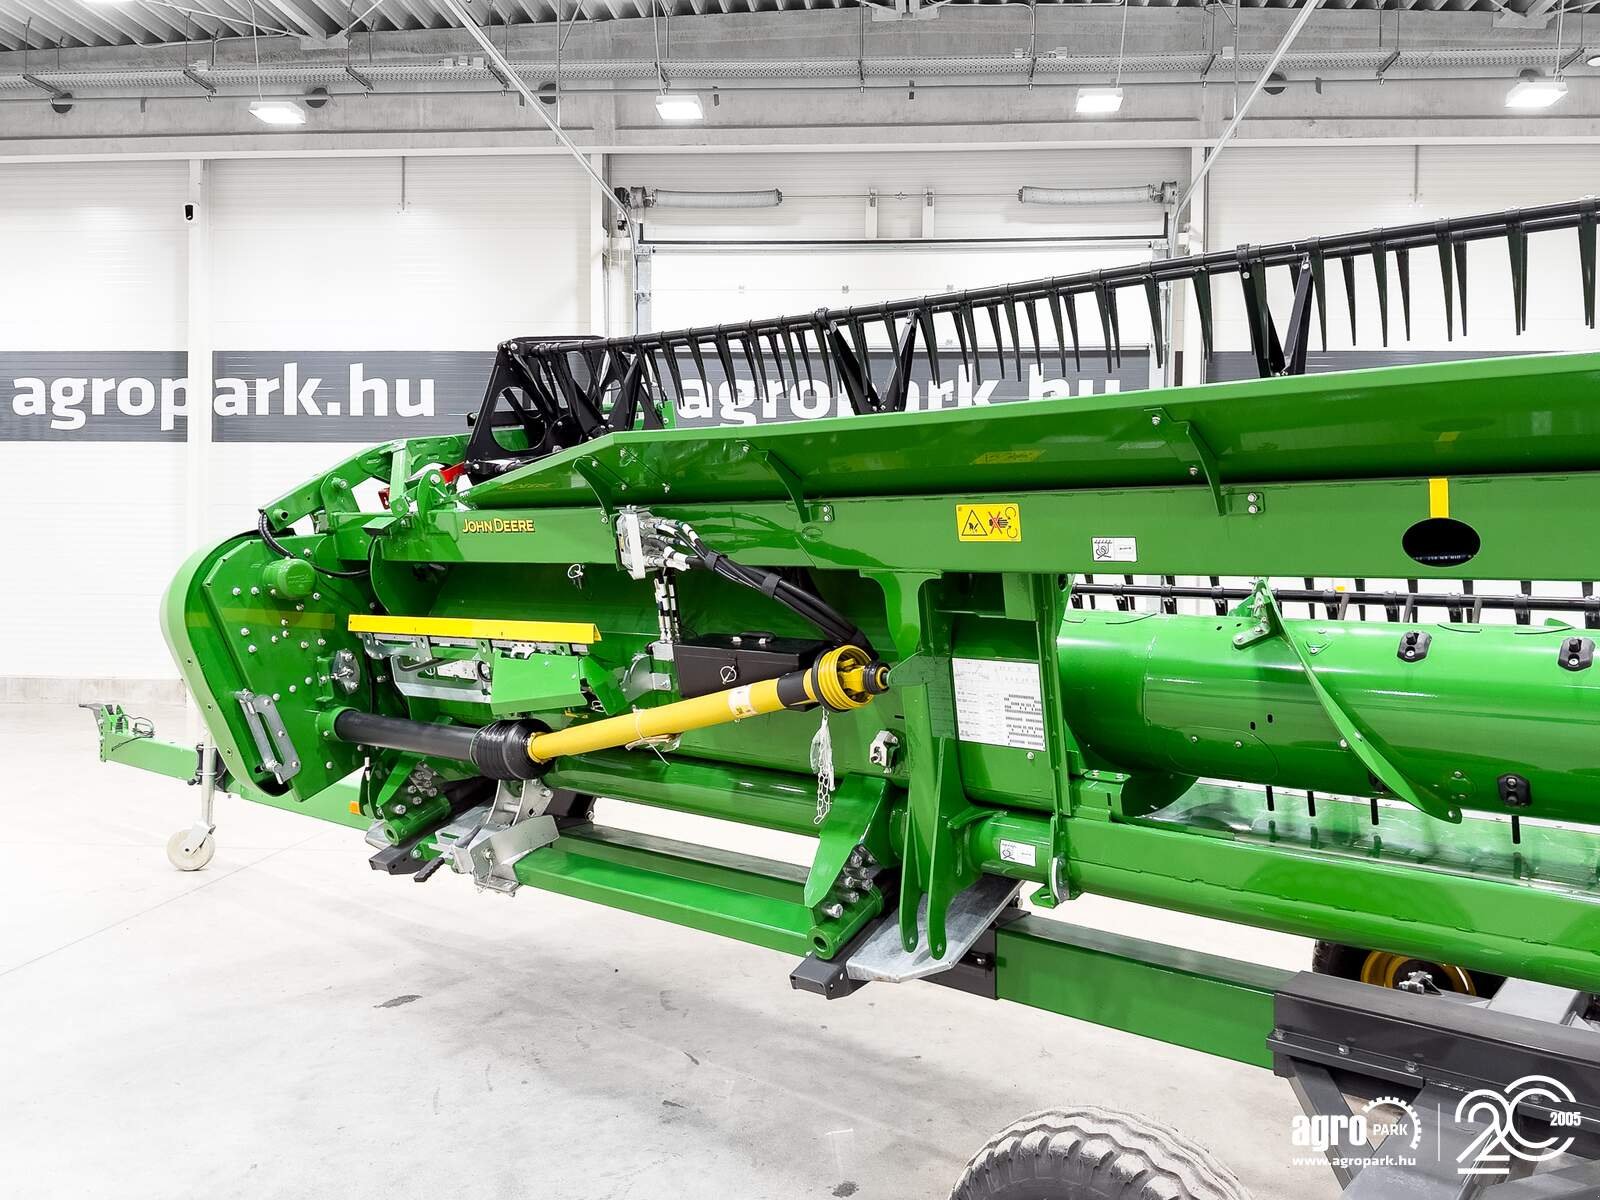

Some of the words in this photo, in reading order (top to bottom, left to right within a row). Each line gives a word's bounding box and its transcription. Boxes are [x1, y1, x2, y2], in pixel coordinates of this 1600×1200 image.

[11, 362, 435, 431] agropark.hu
[463, 518, 492, 533] JOHN
[494, 518, 535, 533] DEERE
